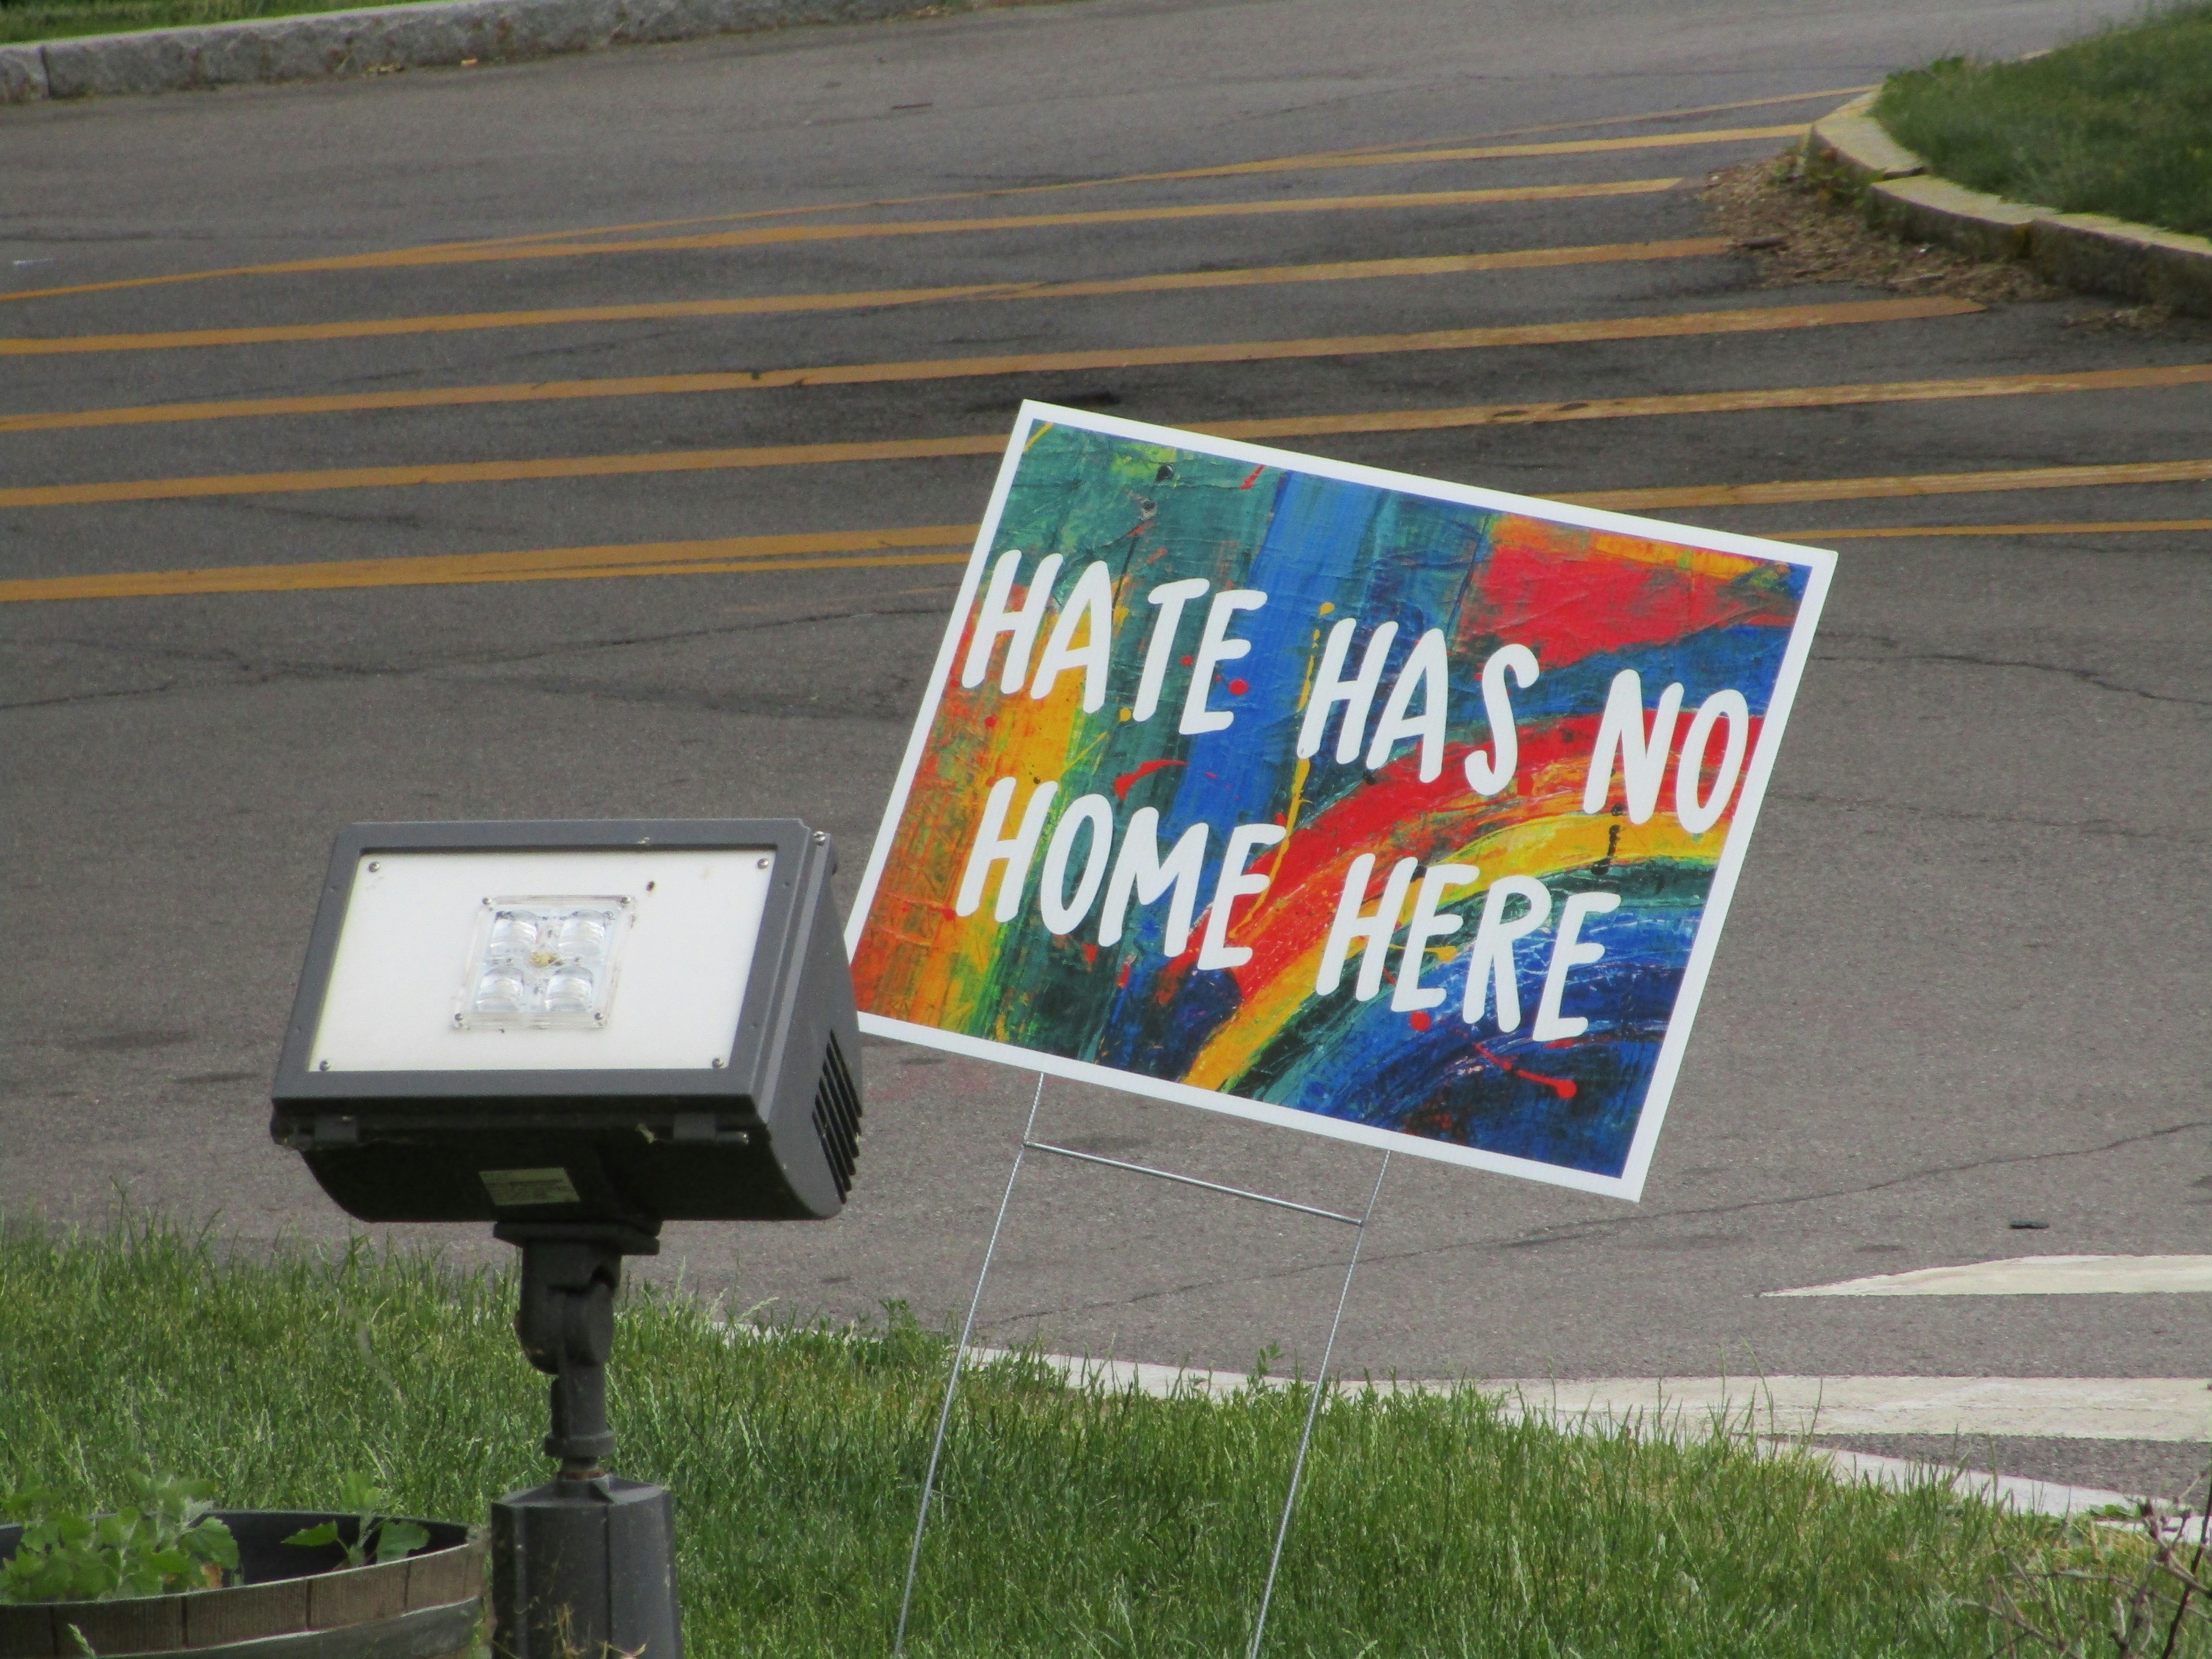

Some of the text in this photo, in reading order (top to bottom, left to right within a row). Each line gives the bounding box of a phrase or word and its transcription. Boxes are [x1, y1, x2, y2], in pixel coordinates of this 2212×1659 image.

[961, 549, 1749, 834] HATE HAS NO
[956, 777, 1621, 1042] HOME HERE
